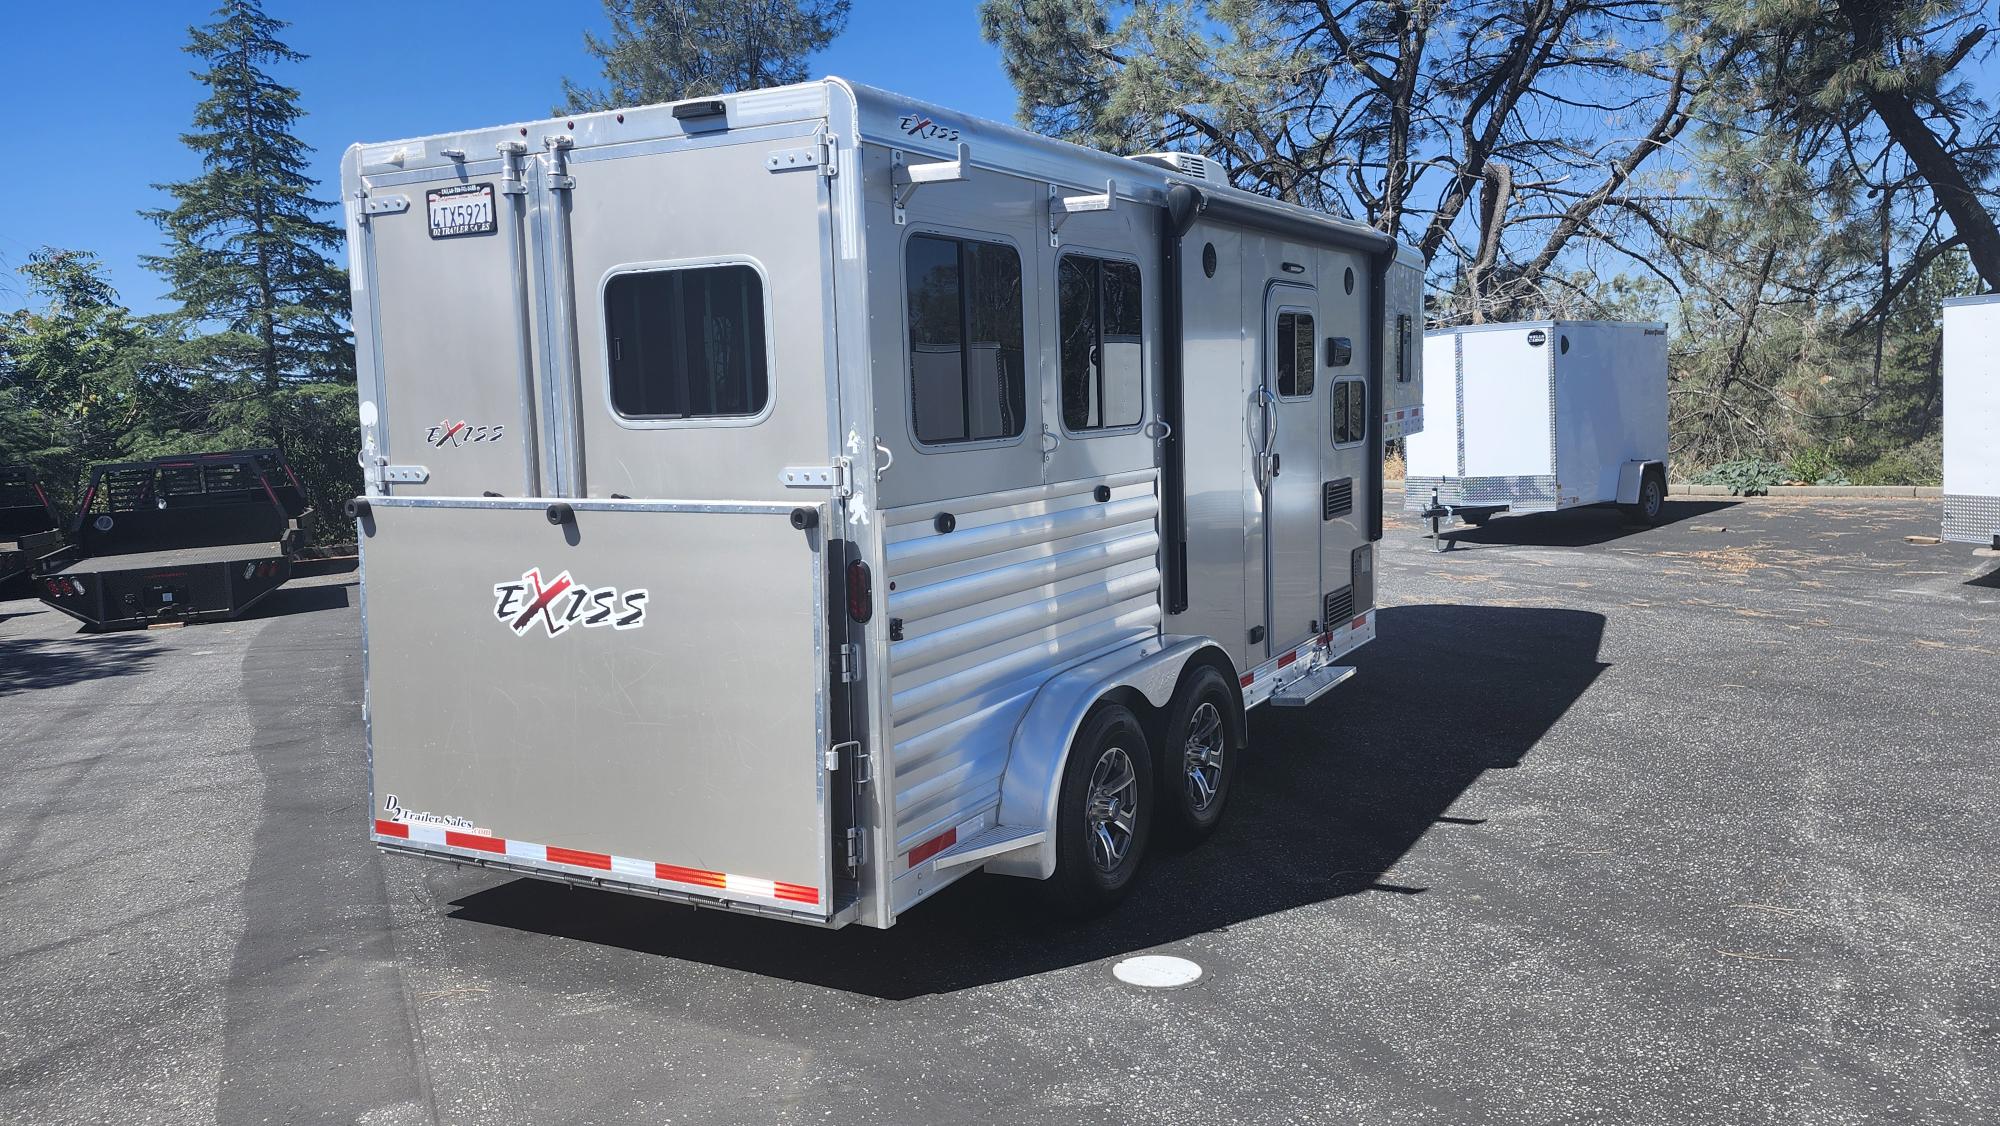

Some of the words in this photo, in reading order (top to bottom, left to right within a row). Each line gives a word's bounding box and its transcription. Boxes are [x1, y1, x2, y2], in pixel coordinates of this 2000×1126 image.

[898, 113, 960, 142] EXISS
[432, 202, 489, 228] 4TX5921
[441, 223, 469, 235] TRAILER
[469, 222, 491, 232] SALES
[425, 418, 505, 449] EXISS
[495, 568, 648, 637] EXISS
[401, 809, 442, 825] Trailer
[443, 814, 473, 829] Sales
